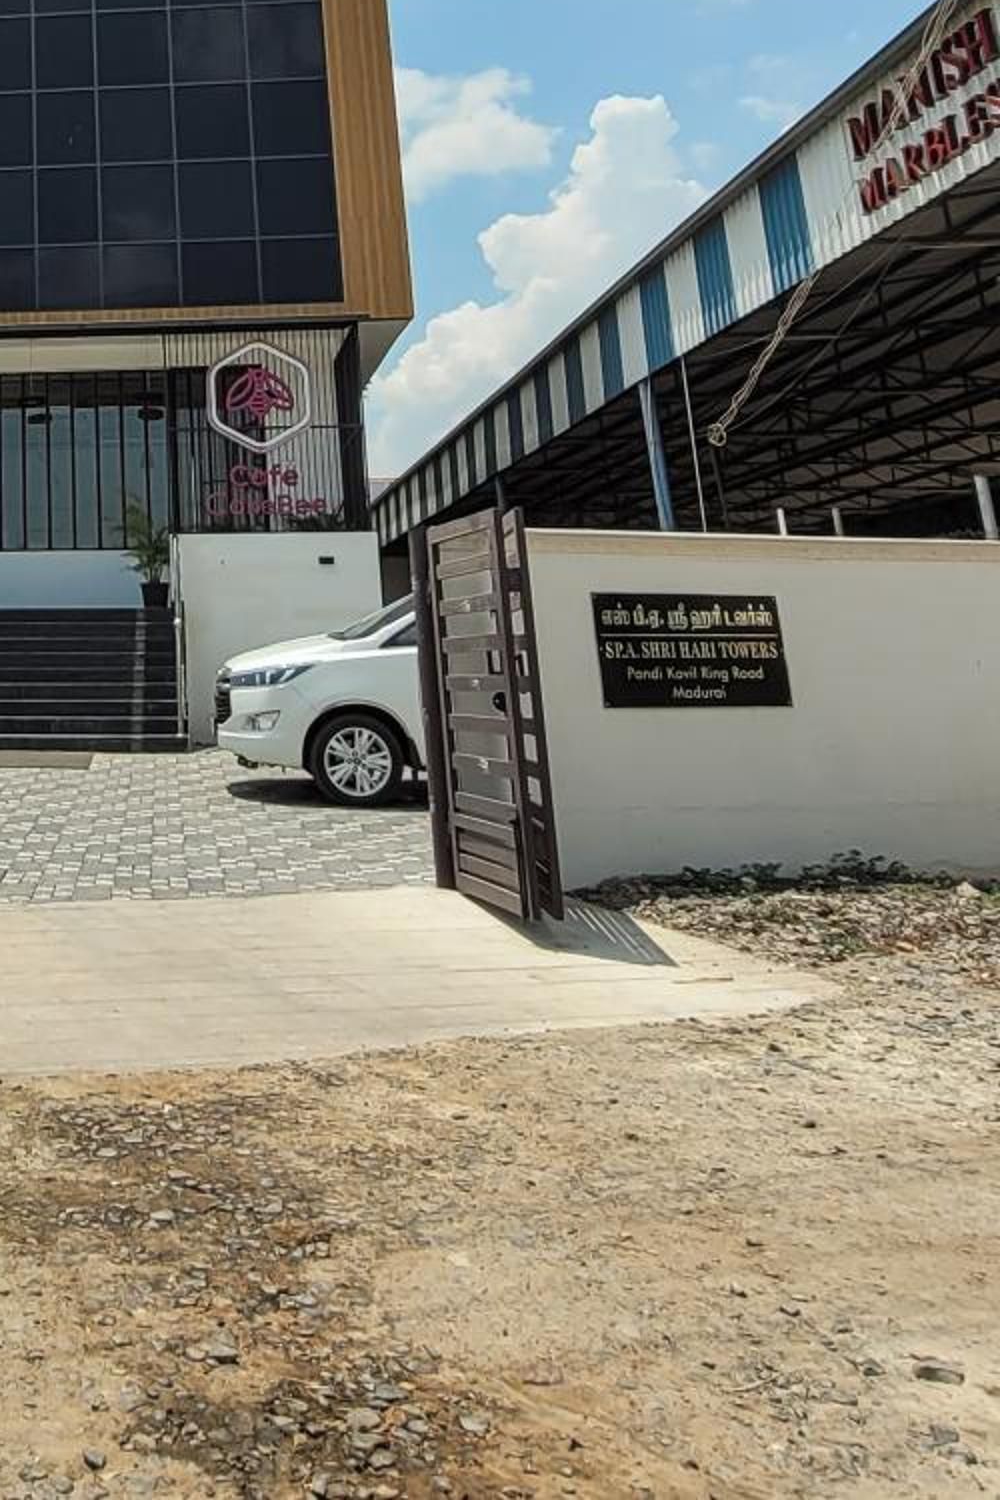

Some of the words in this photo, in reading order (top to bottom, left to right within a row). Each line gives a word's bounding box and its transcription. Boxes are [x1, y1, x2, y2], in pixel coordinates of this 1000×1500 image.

[641, 641, 677, 659] SHRI
[679, 641, 717, 659] HARI
[718, 641, 779, 659] TOWERS
[732, 666, 765, 680] Road
[673, 686, 727, 699] Madurai
